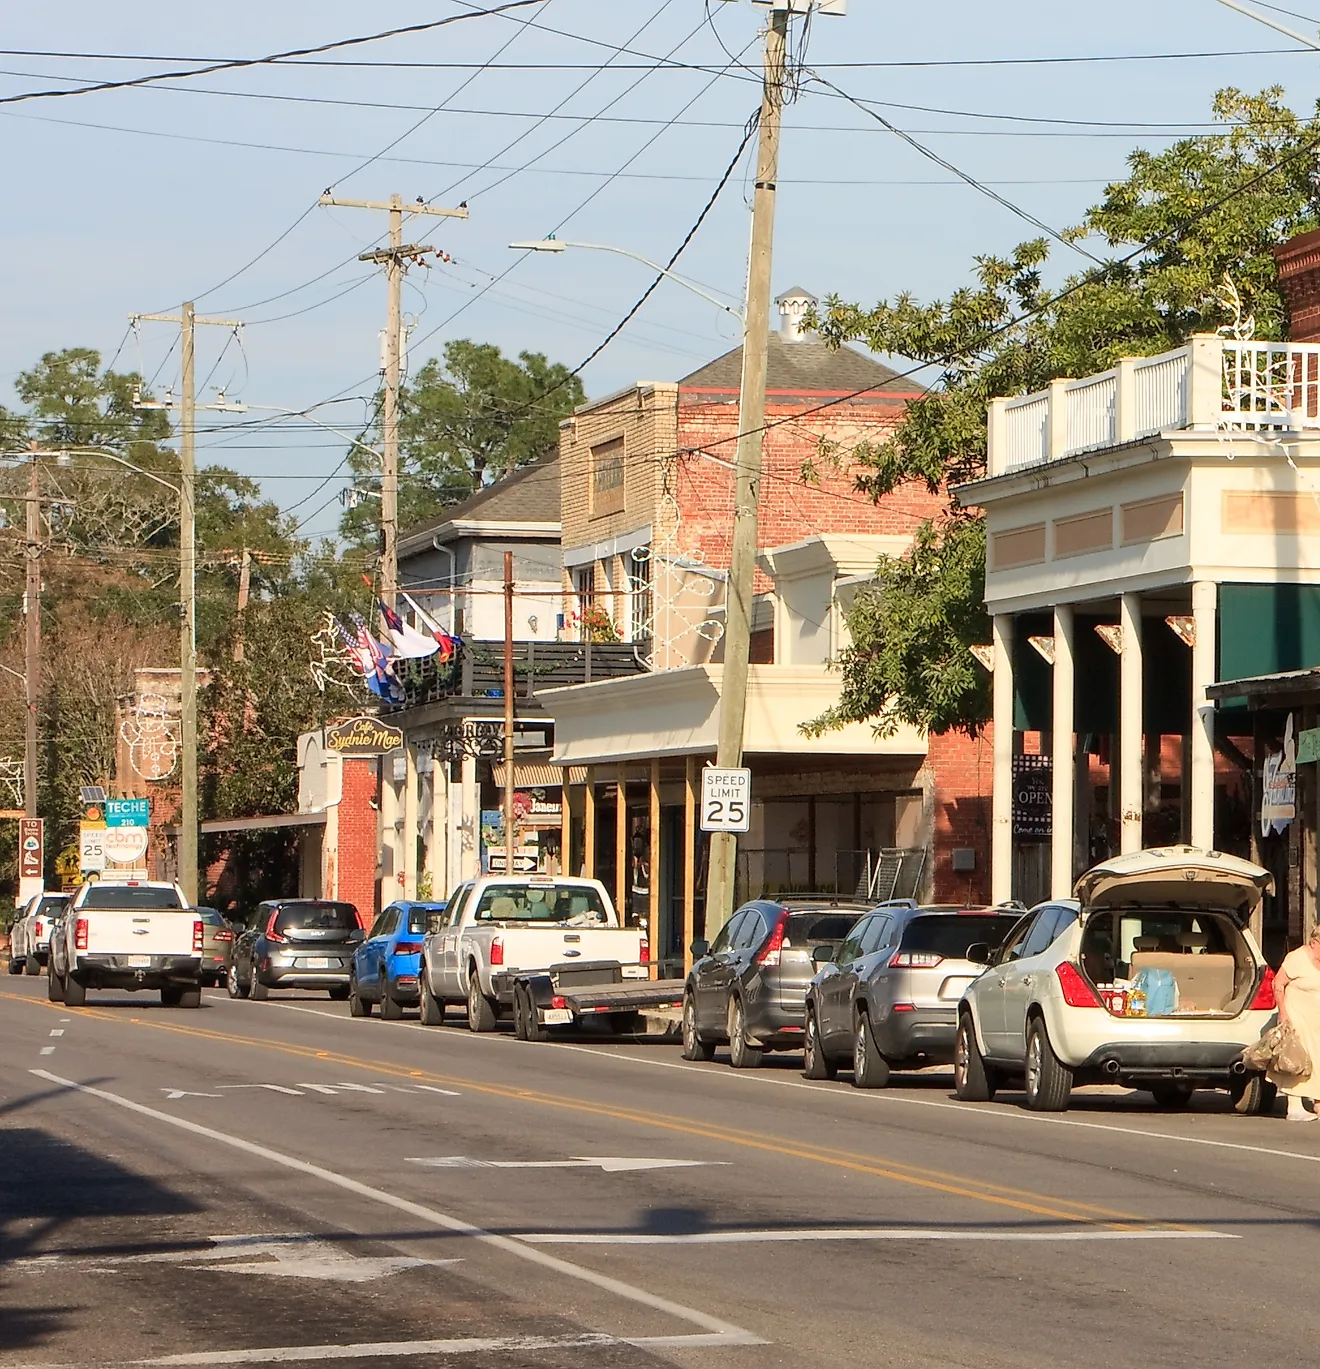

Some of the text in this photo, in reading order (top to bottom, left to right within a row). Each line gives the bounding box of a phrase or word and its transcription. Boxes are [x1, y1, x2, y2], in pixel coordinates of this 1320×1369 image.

[328, 730, 401, 750] Sydnie Mae
[707, 775, 746, 786] SPEED
[710, 788, 741, 798] LIMIT
[1018, 791, 1053, 804] OPEN
[107, 802, 146, 813] TECHE
[707, 800, 744, 823] 25
[121, 818, 135, 826] 210
[106, 828, 143, 843] cbm
[83, 844, 103, 856] 25
